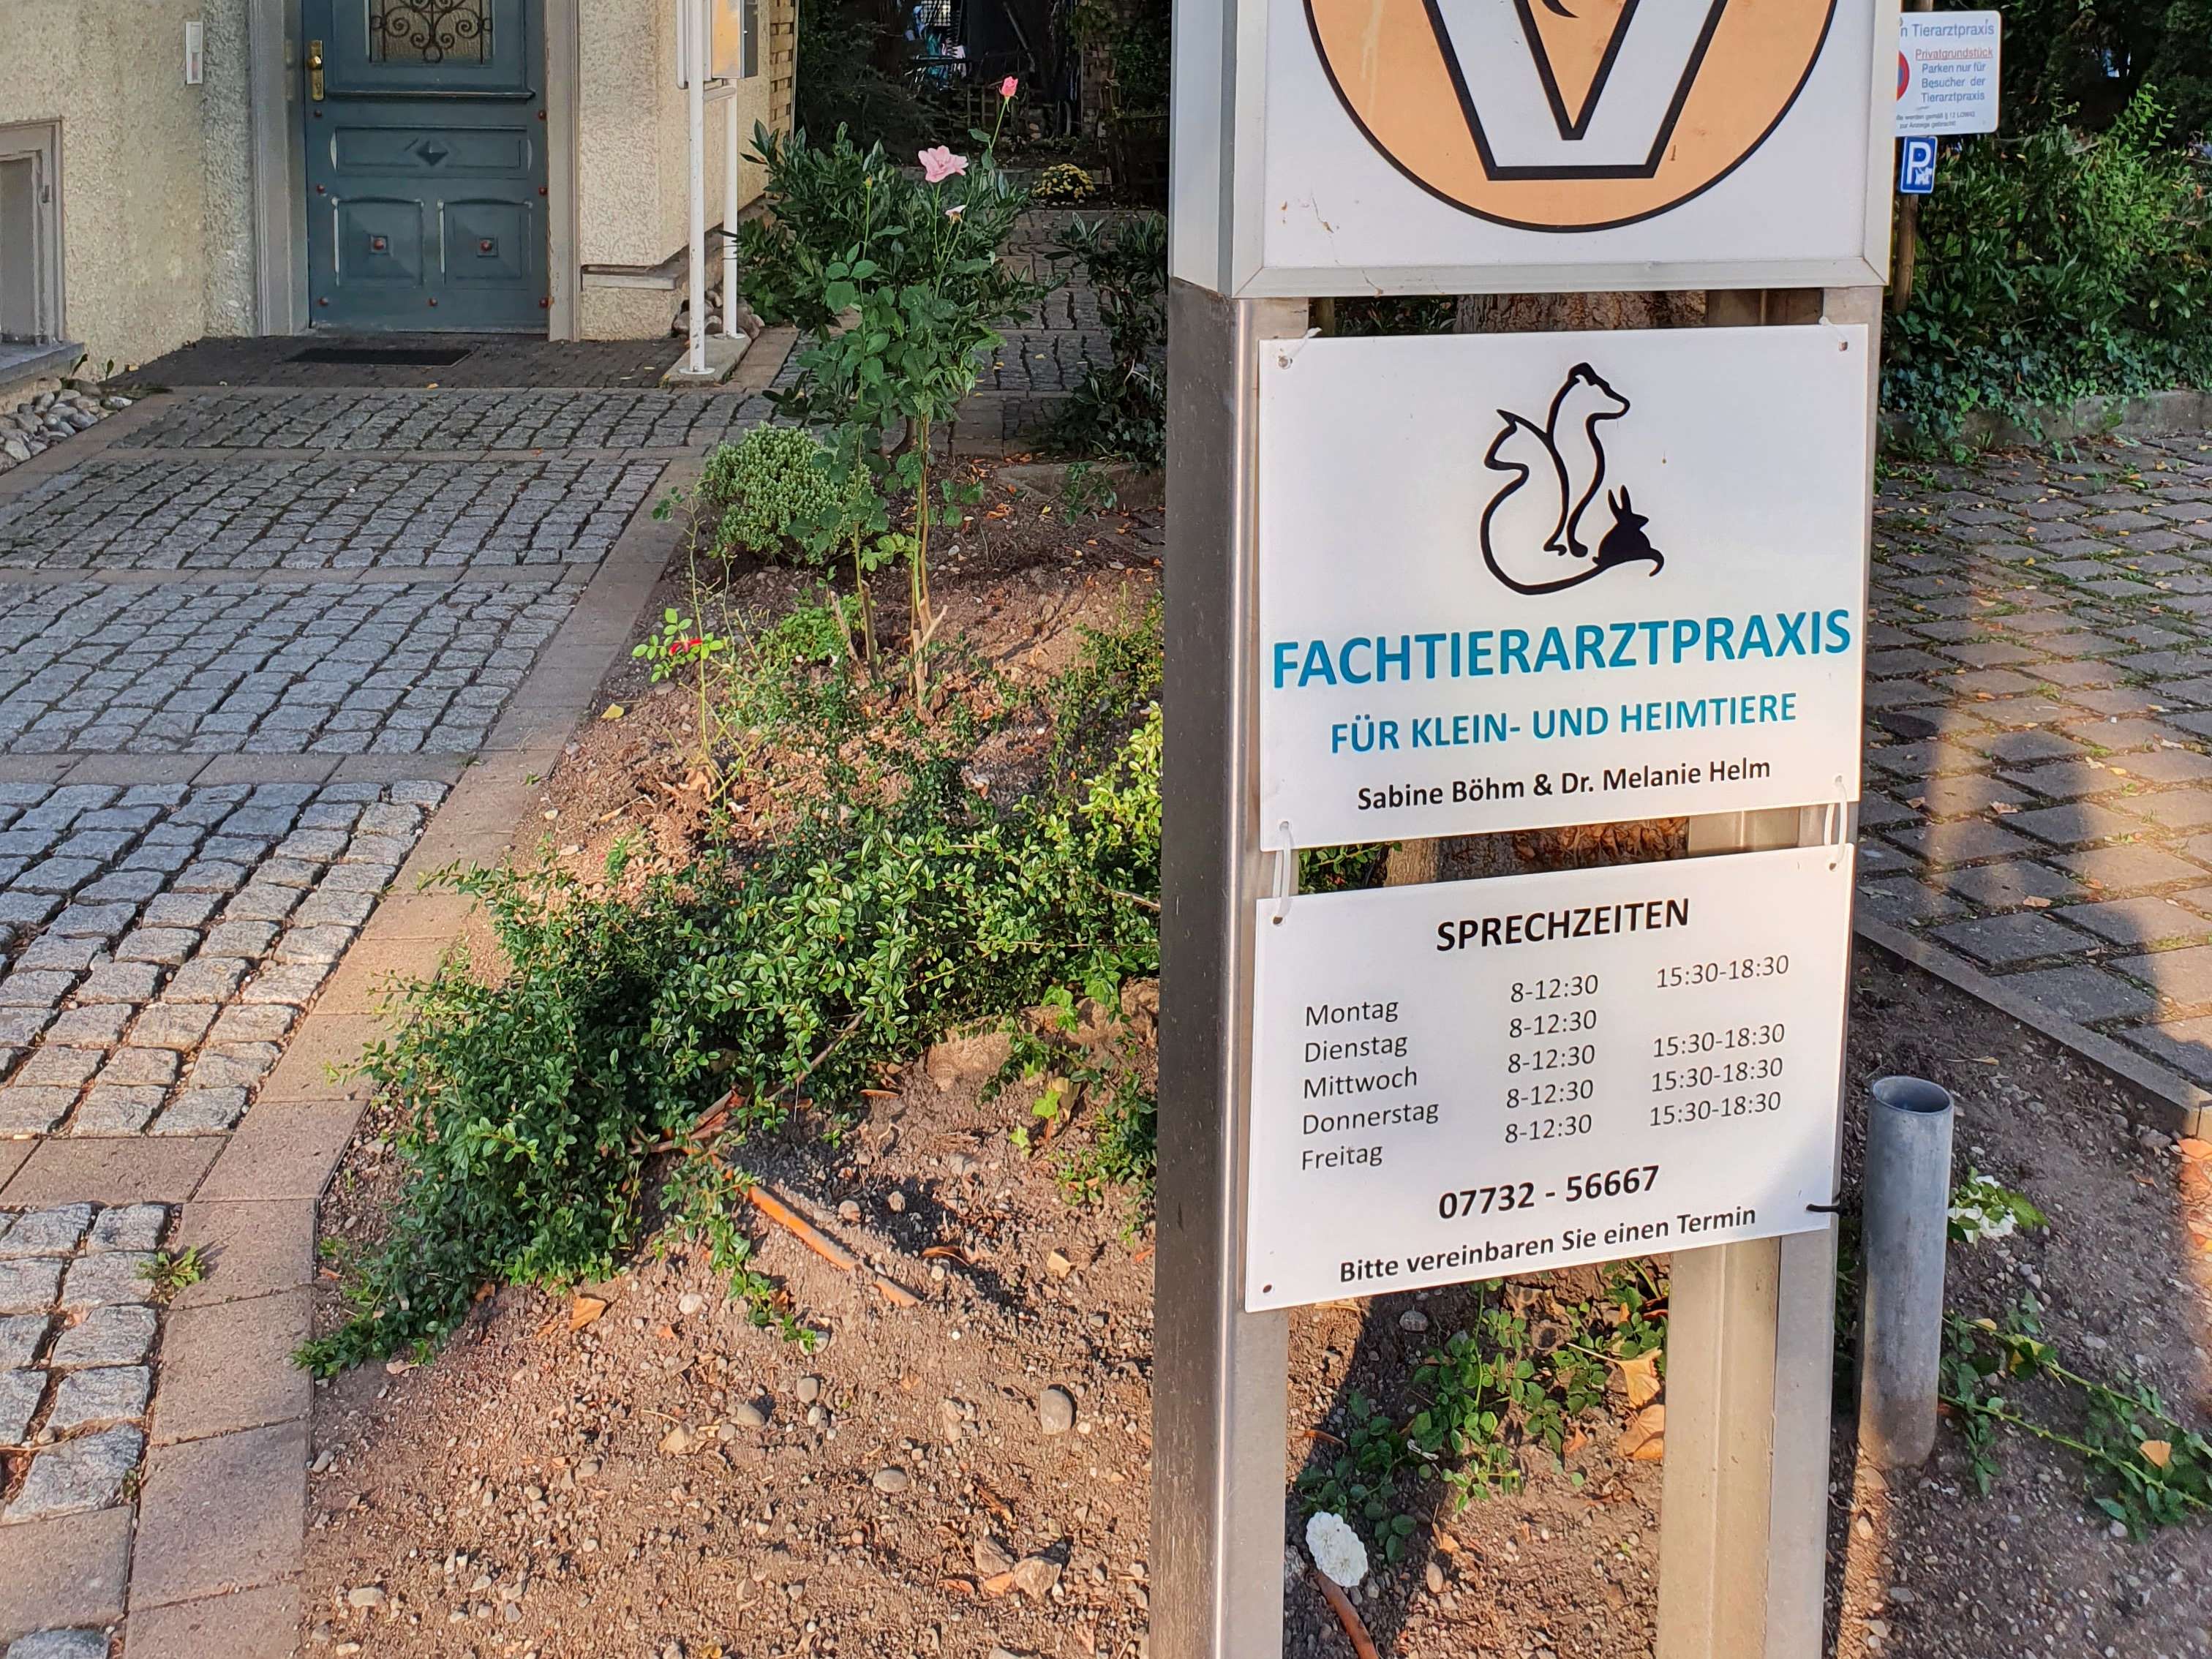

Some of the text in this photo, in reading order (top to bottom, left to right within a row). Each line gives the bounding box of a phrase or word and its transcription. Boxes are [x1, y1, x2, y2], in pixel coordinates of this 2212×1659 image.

[1912, 22, 1994, 38] Tierarztpraxis
[1916, 48, 1993, 61] Privatgrundstück
[1922, 61, 1987, 73] Parken nur für
[1922, 76, 1986, 89] Besucher der
[1922, 91, 1985, 103] Tierarztpraxis
[1274, 609, 1851, 689] FACHTIERARZTPRAXIS
[1331, 692, 1797, 754] FÜR KLEIN- UND HEIMTIERE
[1358, 757, 1770, 810] Sabine Böhm & Dr. Melanie Helm
[1437, 898, 1689, 952] SPRECHZEITEN
[1306, 955, 1789, 1027] Montag 8-12:30 15:30-18:30
[1304, 1023, 1785, 1099] Mittwoch 8-12:30 15:30-18:30
[1305, 1009, 1597, 1063] Dienstag 8-12:30
[1303, 1057, 1783, 1135] Donnerstag 8-12:30 15:30-18:30
[1302, 1091, 1781, 1171] Freitag 8-12:30 15:30-18:30
[1439, 1181, 1535, 1219] 07732
[1565, 1165, 1659, 1202] 56667
[1340, 1205, 1756, 1283] Bitte vereinbaren Sie einen Termin
